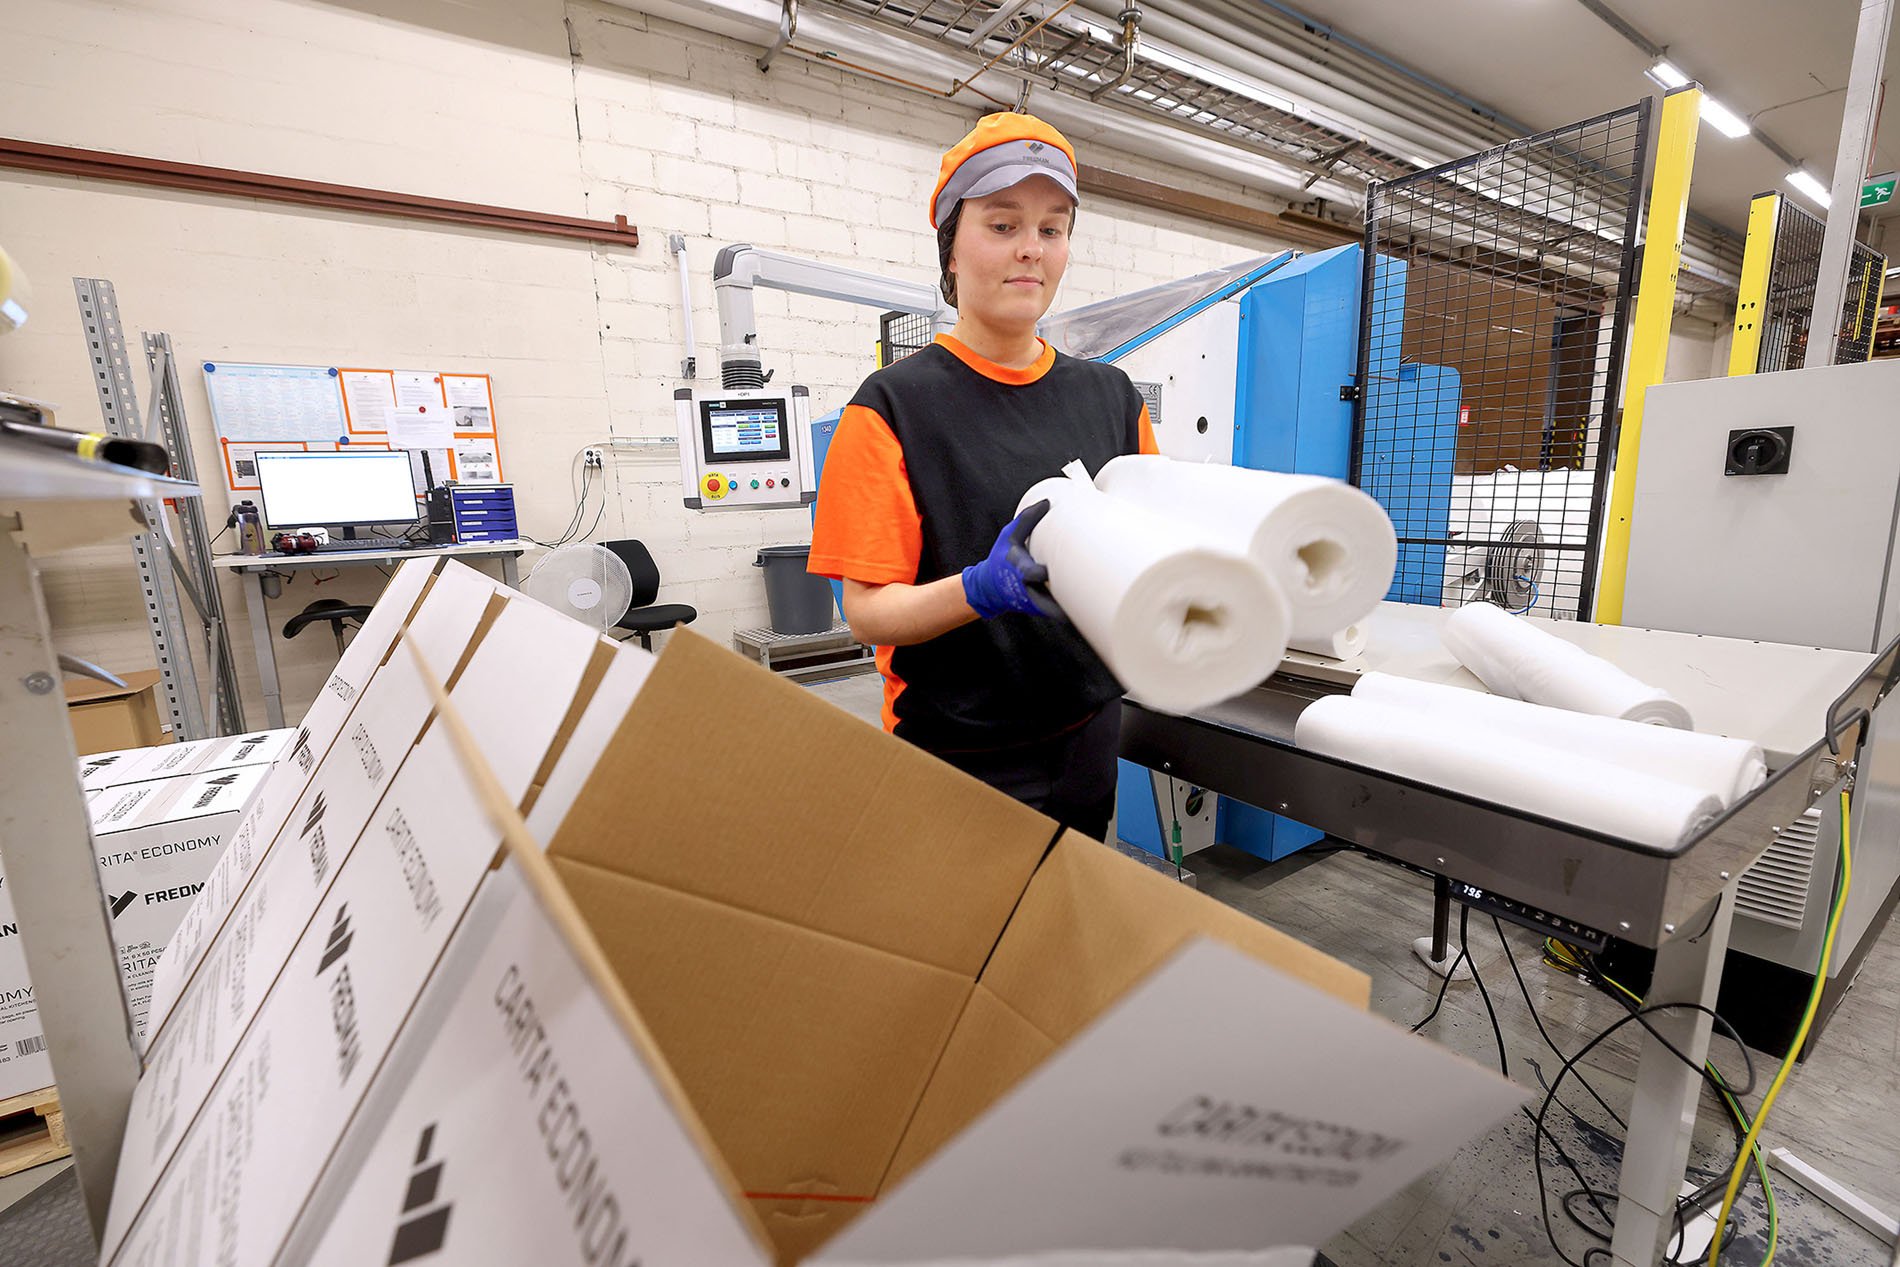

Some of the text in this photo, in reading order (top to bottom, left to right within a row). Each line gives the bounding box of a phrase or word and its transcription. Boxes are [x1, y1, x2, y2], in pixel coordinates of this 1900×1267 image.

[141, 835, 221, 860] ECONOMY
[1535, 911, 1545, 921] 2
[1569, 924, 1579, 934] 4
